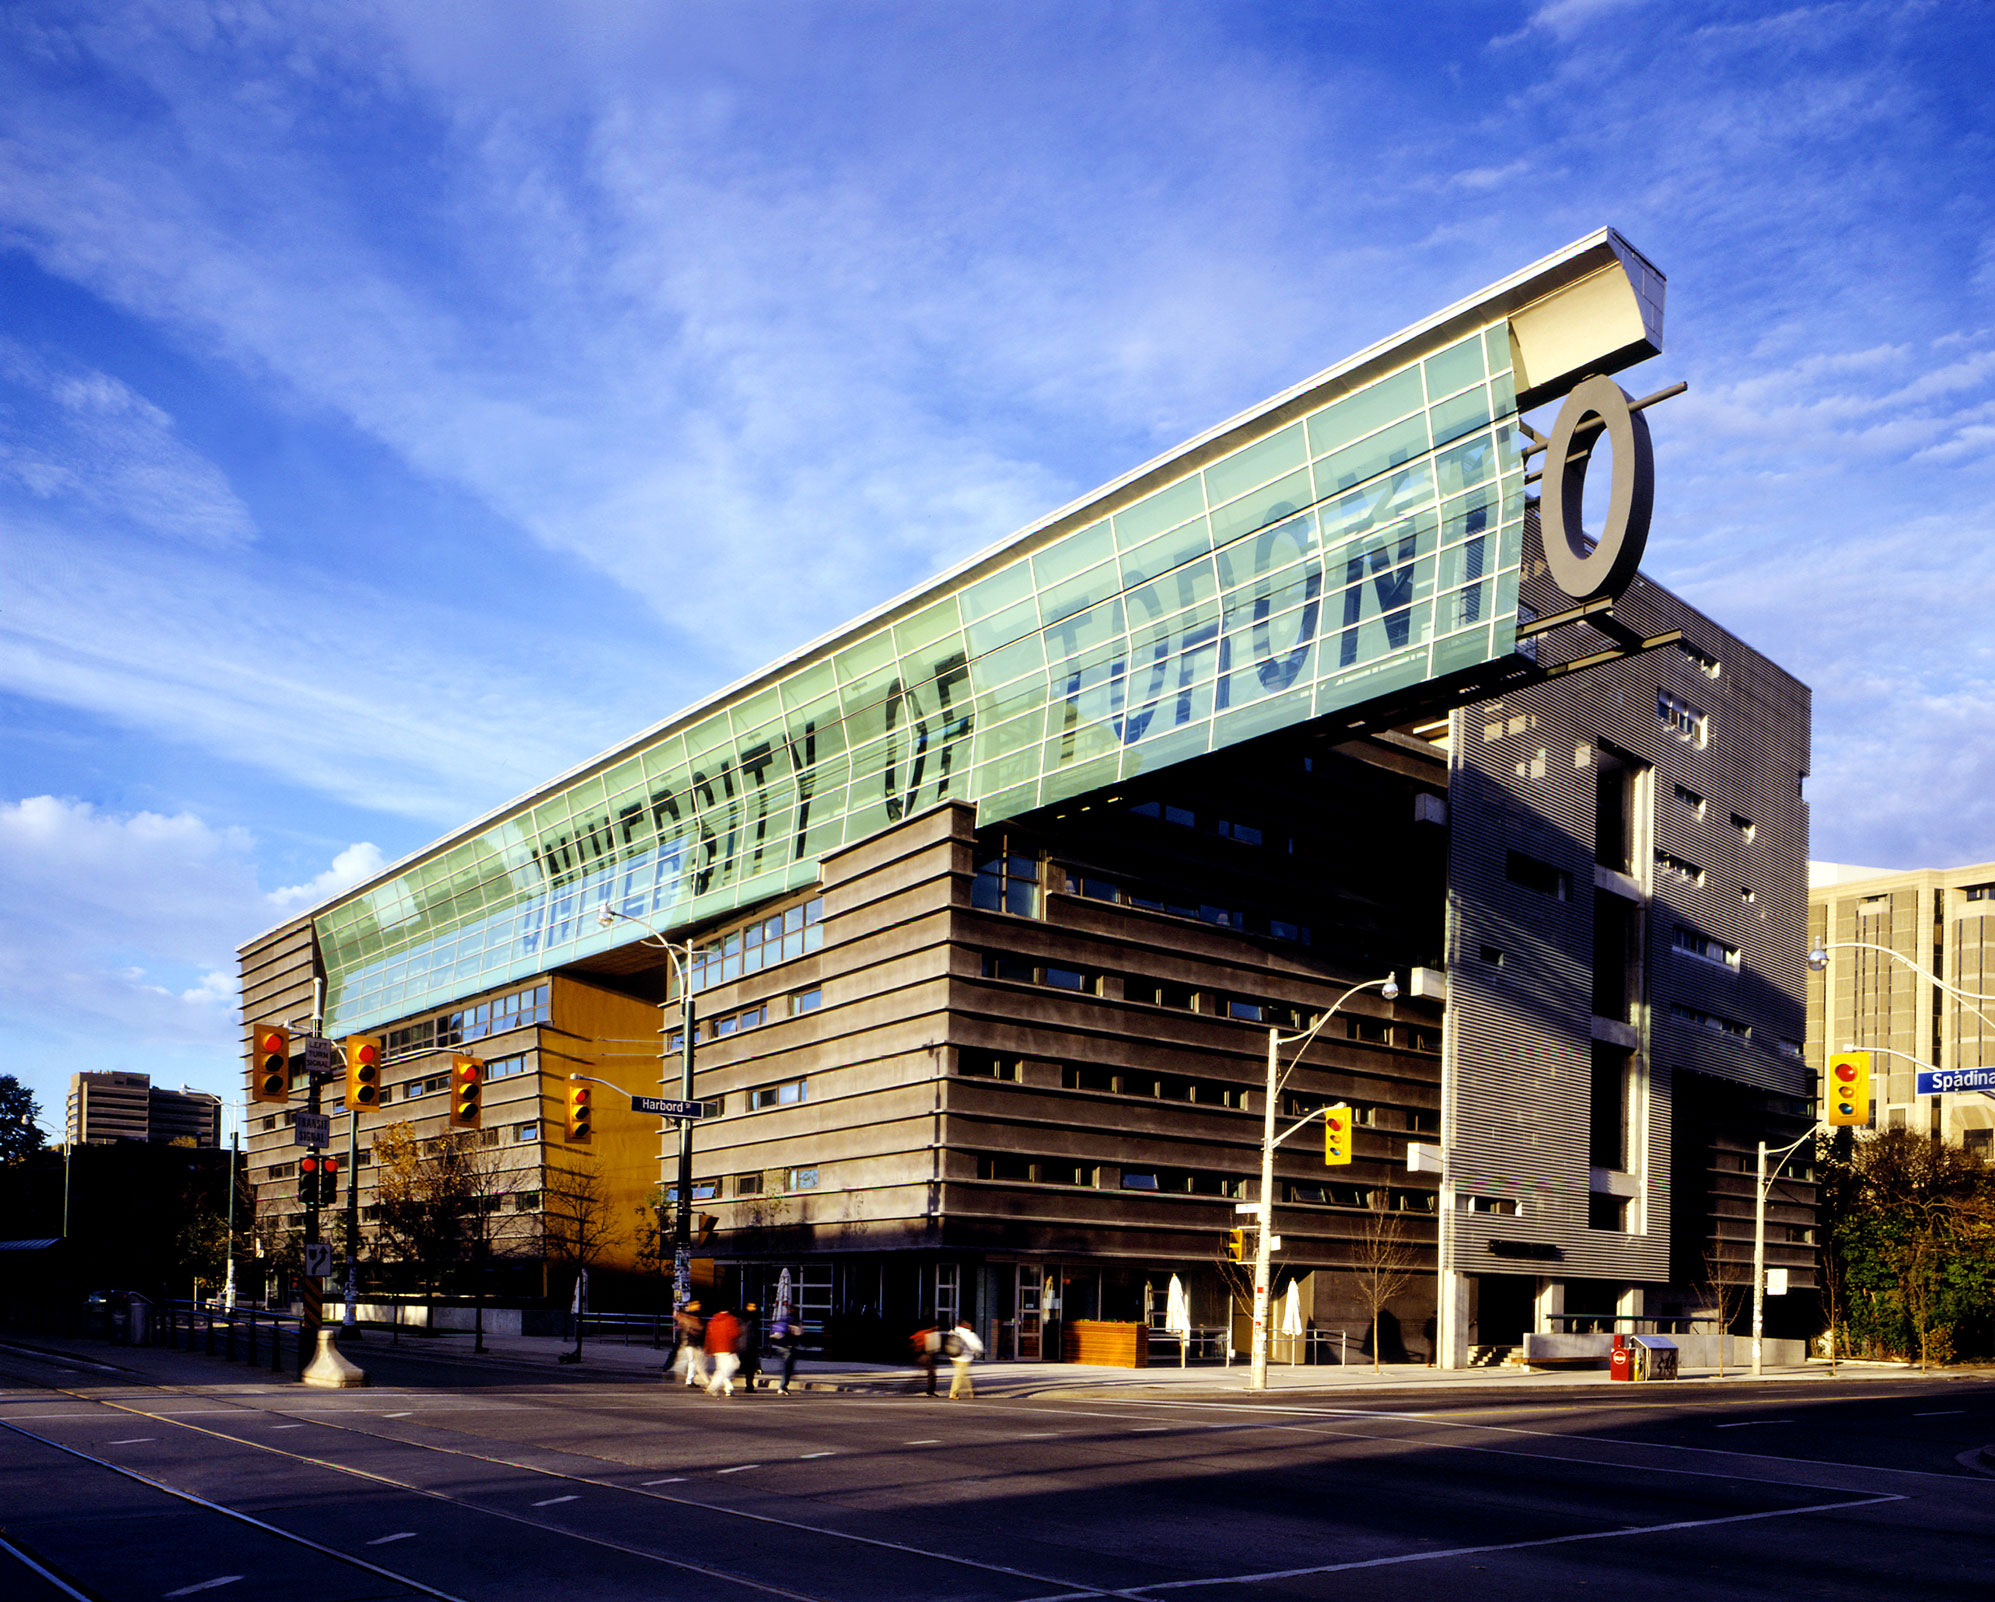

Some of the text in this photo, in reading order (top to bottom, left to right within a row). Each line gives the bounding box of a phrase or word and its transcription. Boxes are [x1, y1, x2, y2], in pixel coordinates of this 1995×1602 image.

[520, 373, 1655, 954] UNIVERSITY OF TORONTO
[309, 1041, 328, 1049] LEFT
[308, 1050, 329, 1059] TURN
[1932, 1070, 1995, 1091] Spadina
[642, 1099, 683, 1113] Harbord
[298, 1117, 328, 1131] TRANSIT
[299, 1130, 325, 1144] SIGNAL
